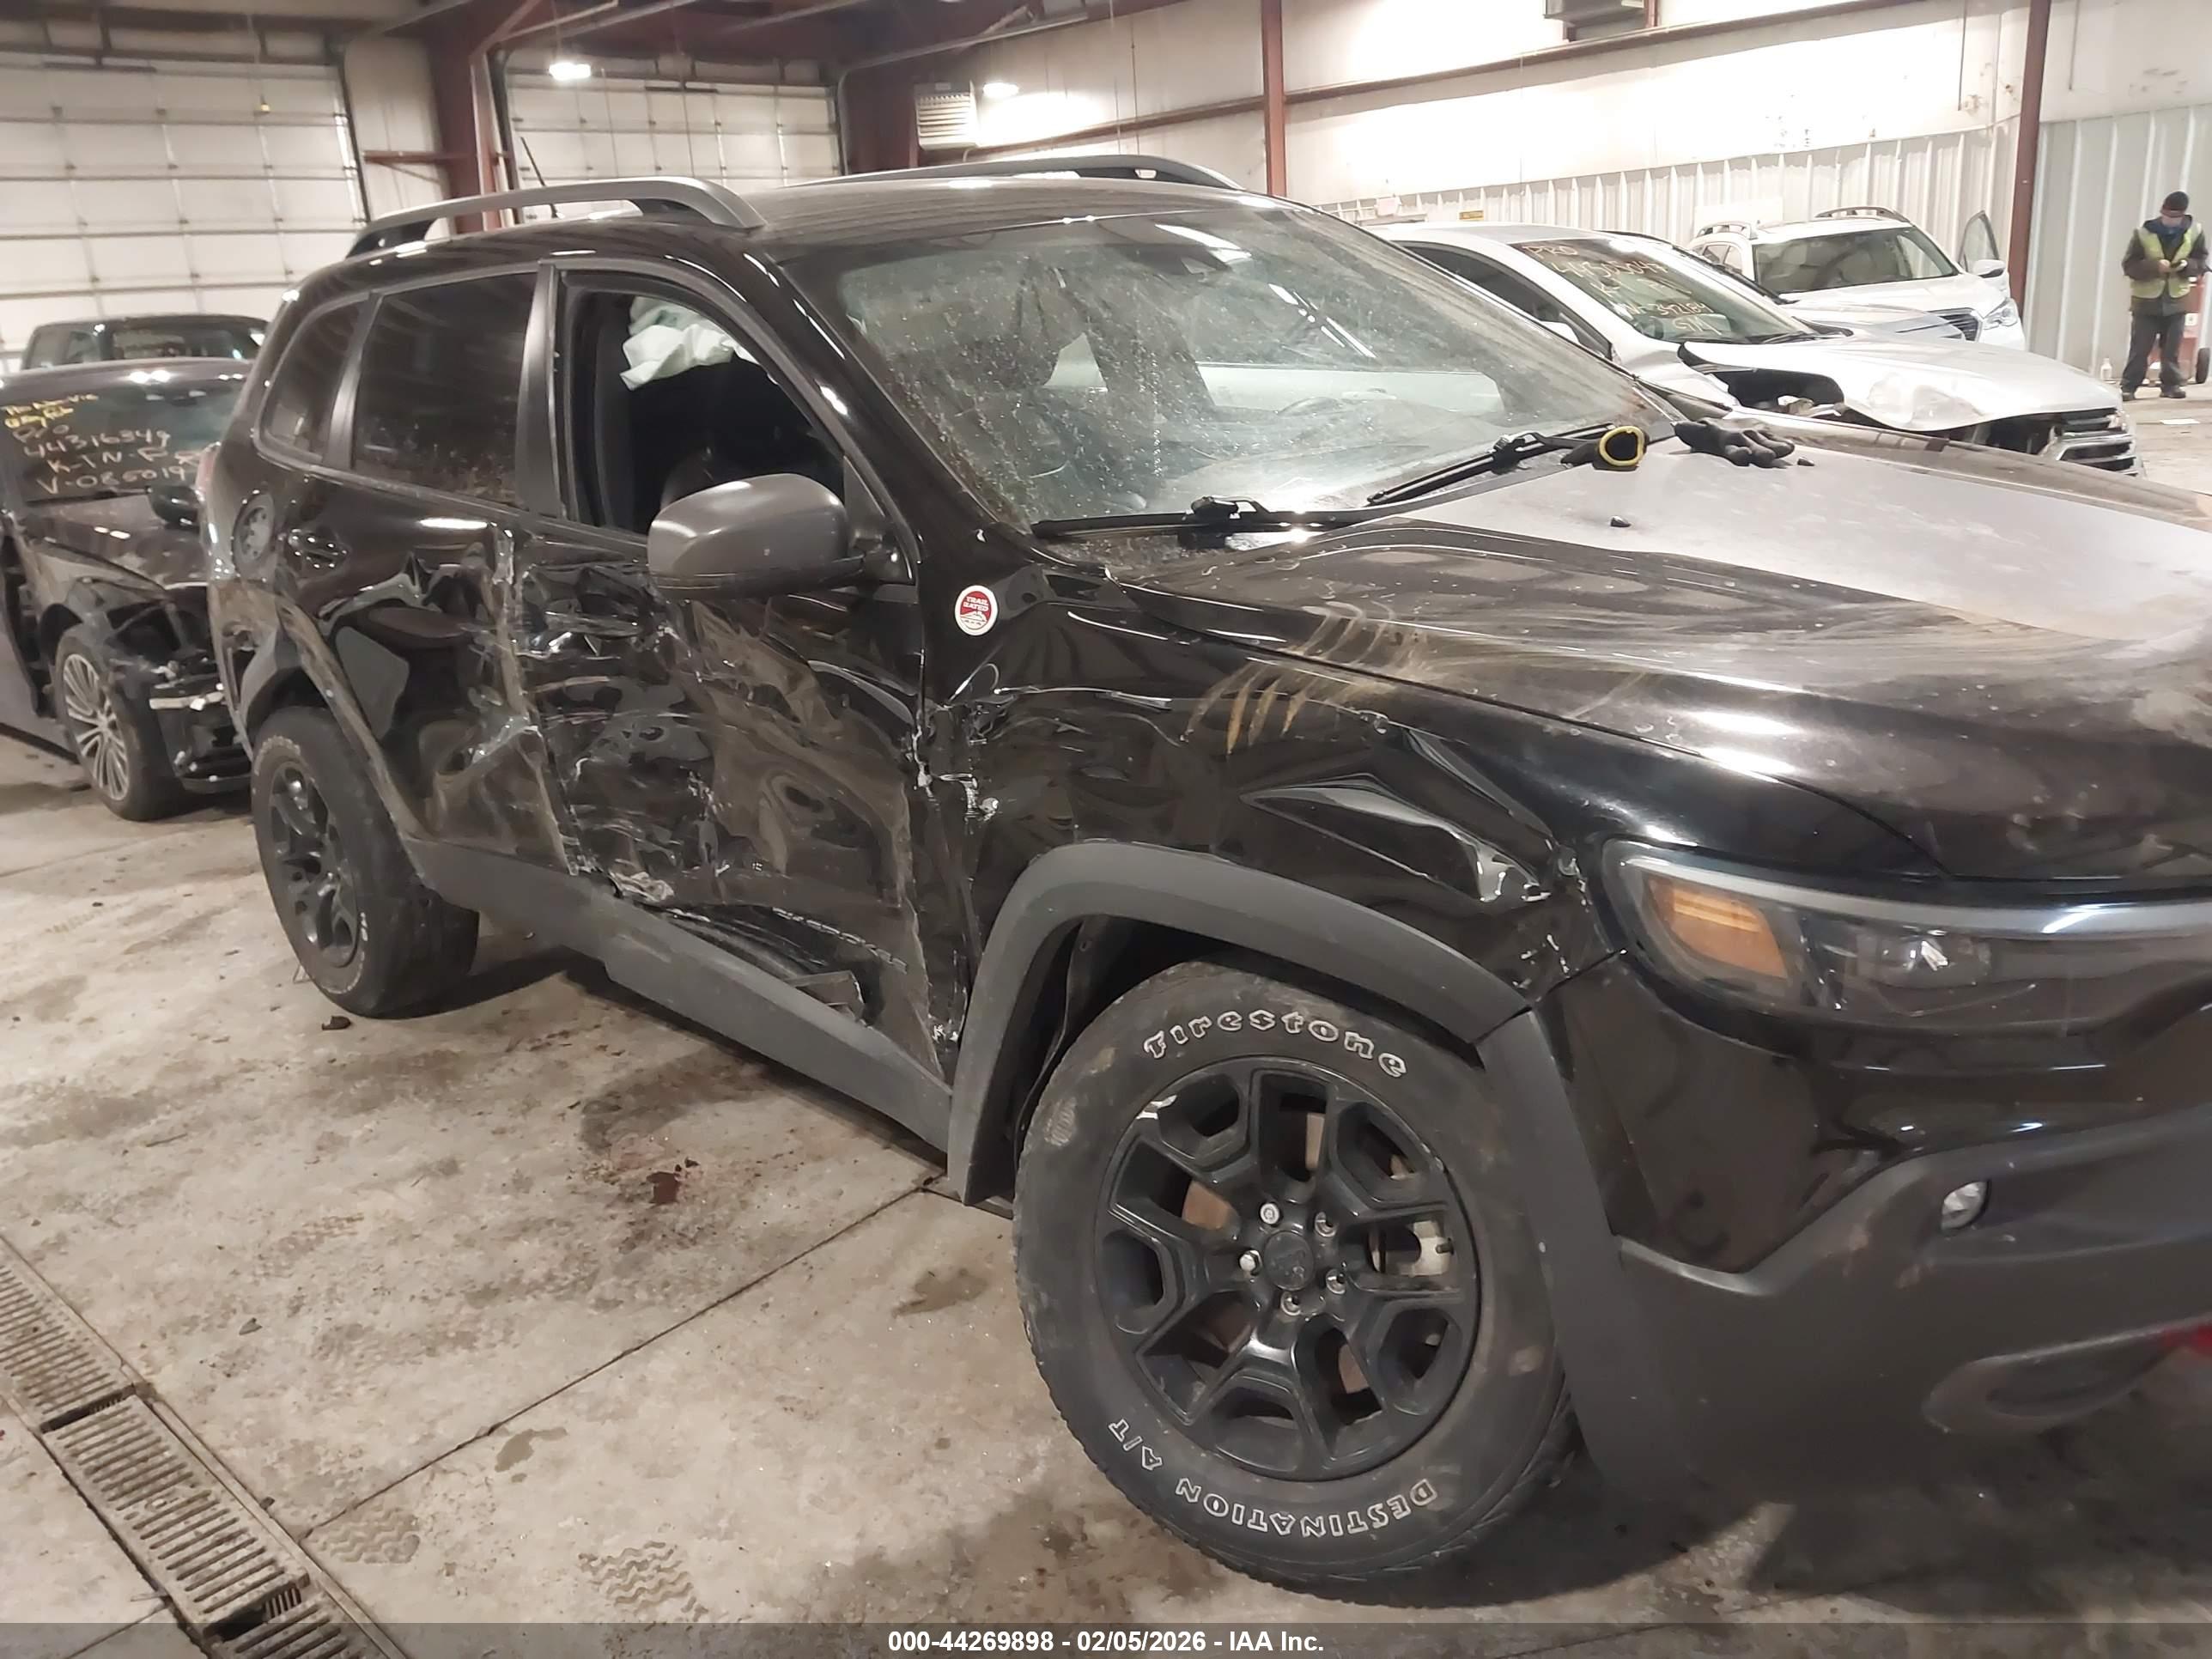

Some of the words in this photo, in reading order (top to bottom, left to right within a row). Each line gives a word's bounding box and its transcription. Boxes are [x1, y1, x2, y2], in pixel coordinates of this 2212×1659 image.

[1143, 1009, 1407, 1079] Firestone
[1108, 1418, 1164, 1471] A/T
[1175, 1477, 1437, 1539] DESTINATION
